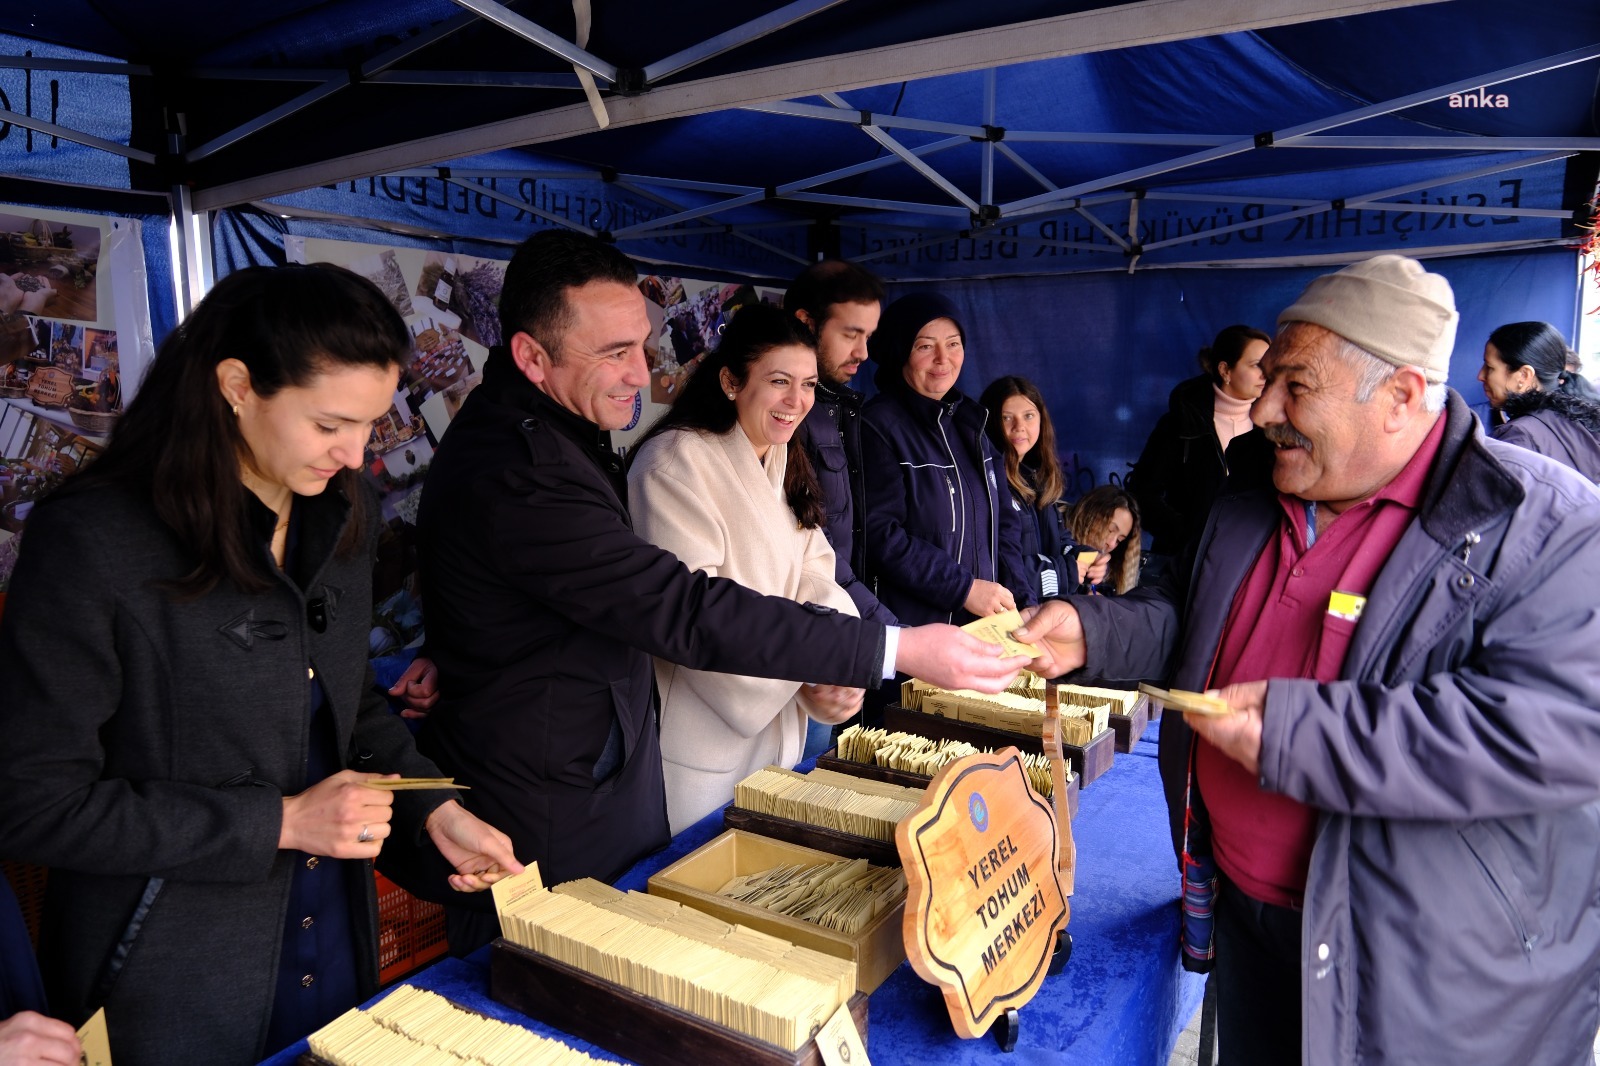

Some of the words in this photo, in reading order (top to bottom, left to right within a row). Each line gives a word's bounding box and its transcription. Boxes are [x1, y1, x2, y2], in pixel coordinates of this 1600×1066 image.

[968, 835, 1018, 890] YEREL
[976, 862, 1031, 929] TOHUM
[981, 883, 1046, 976] MERKEZİ
